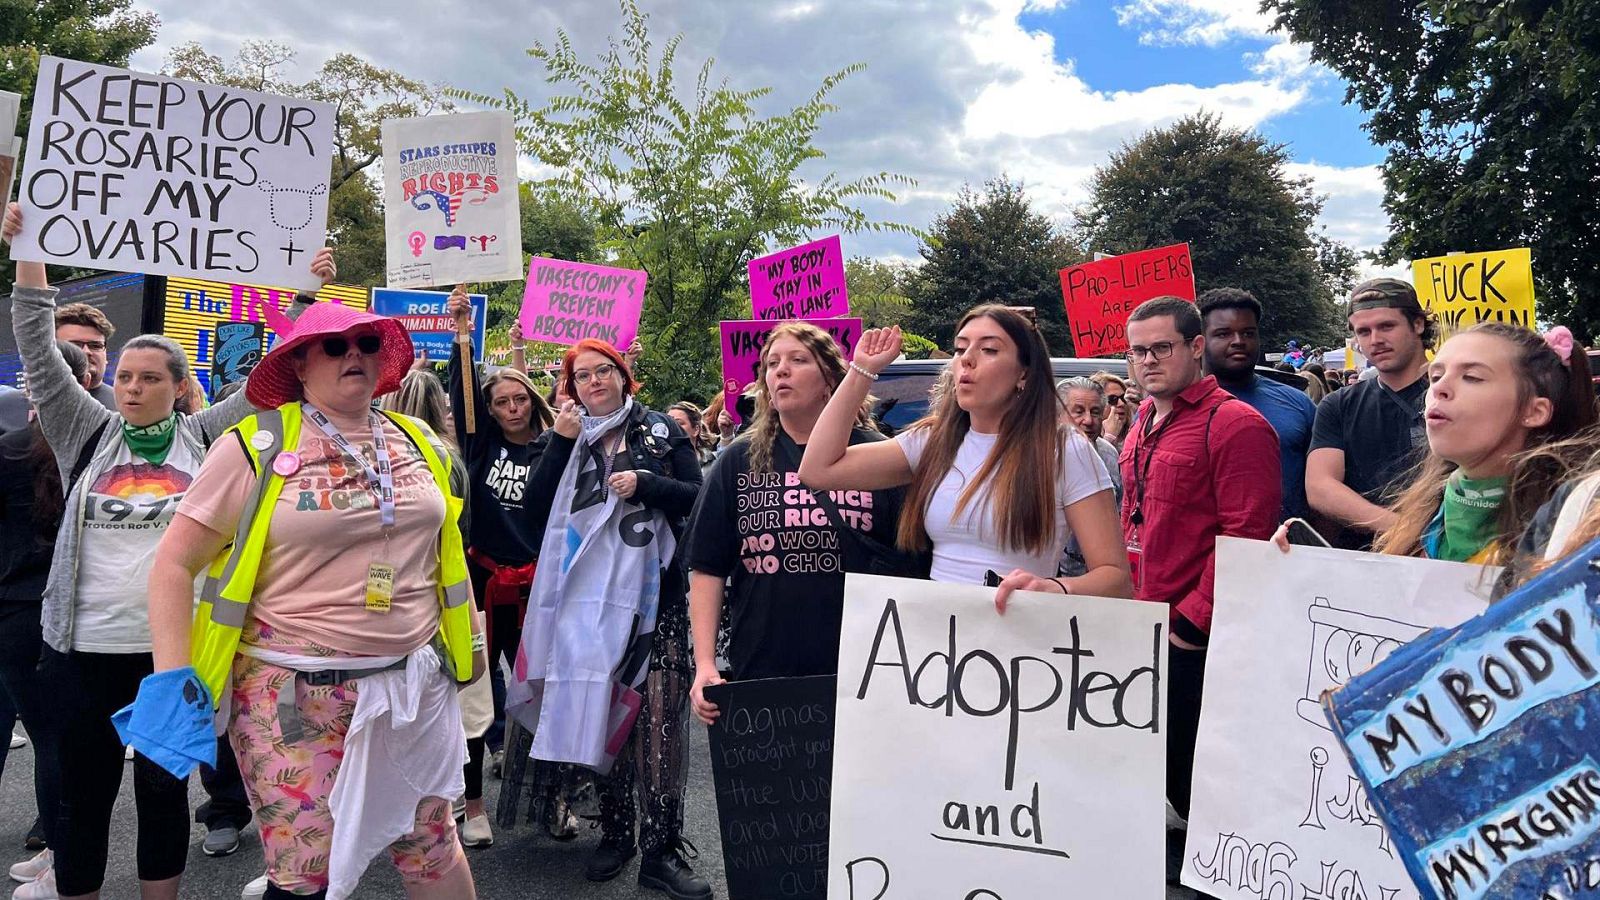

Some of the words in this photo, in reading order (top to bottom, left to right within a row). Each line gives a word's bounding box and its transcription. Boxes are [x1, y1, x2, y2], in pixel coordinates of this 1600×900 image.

[52, 63, 186, 130] KEEP
[198, 89, 316, 157] YOUR
[40, 120, 259, 186] ROSARIES
[400, 144, 440, 164] STARS
[443, 142, 497, 156] STRIPES
[400, 154, 498, 180] REPRODUCTIVE
[28, 168, 124, 216] OFF
[144, 179, 231, 222] MY
[402, 172, 499, 201] RIGHTS
[38, 214, 259, 273] OVARIES
[773, 277, 801, 301] STAY
[807, 272, 822, 292] IN
[1430, 258, 1507, 304] FUCK
[179, 290, 227, 314] The
[408, 303, 439, 315] ROE
[548, 291, 616, 319] PREVENT
[759, 302, 797, 320] YOUR
[533, 315, 620, 346] ABORTIONS
[737, 472, 781, 491] OUR
[85, 496, 183, 521] 197
[737, 491, 780, 512] OUR
[738, 510, 780, 534] OUR
[856, 598, 1162, 791] Adopted
[1363, 694, 1451, 775] MY
[1438, 608, 1598, 735] BODY
[720, 736, 796, 771] brought
[720, 778, 780, 806] the
[943, 782, 1043, 844] and
[729, 812, 779, 845] and
[1427, 837, 1490, 900] MY
